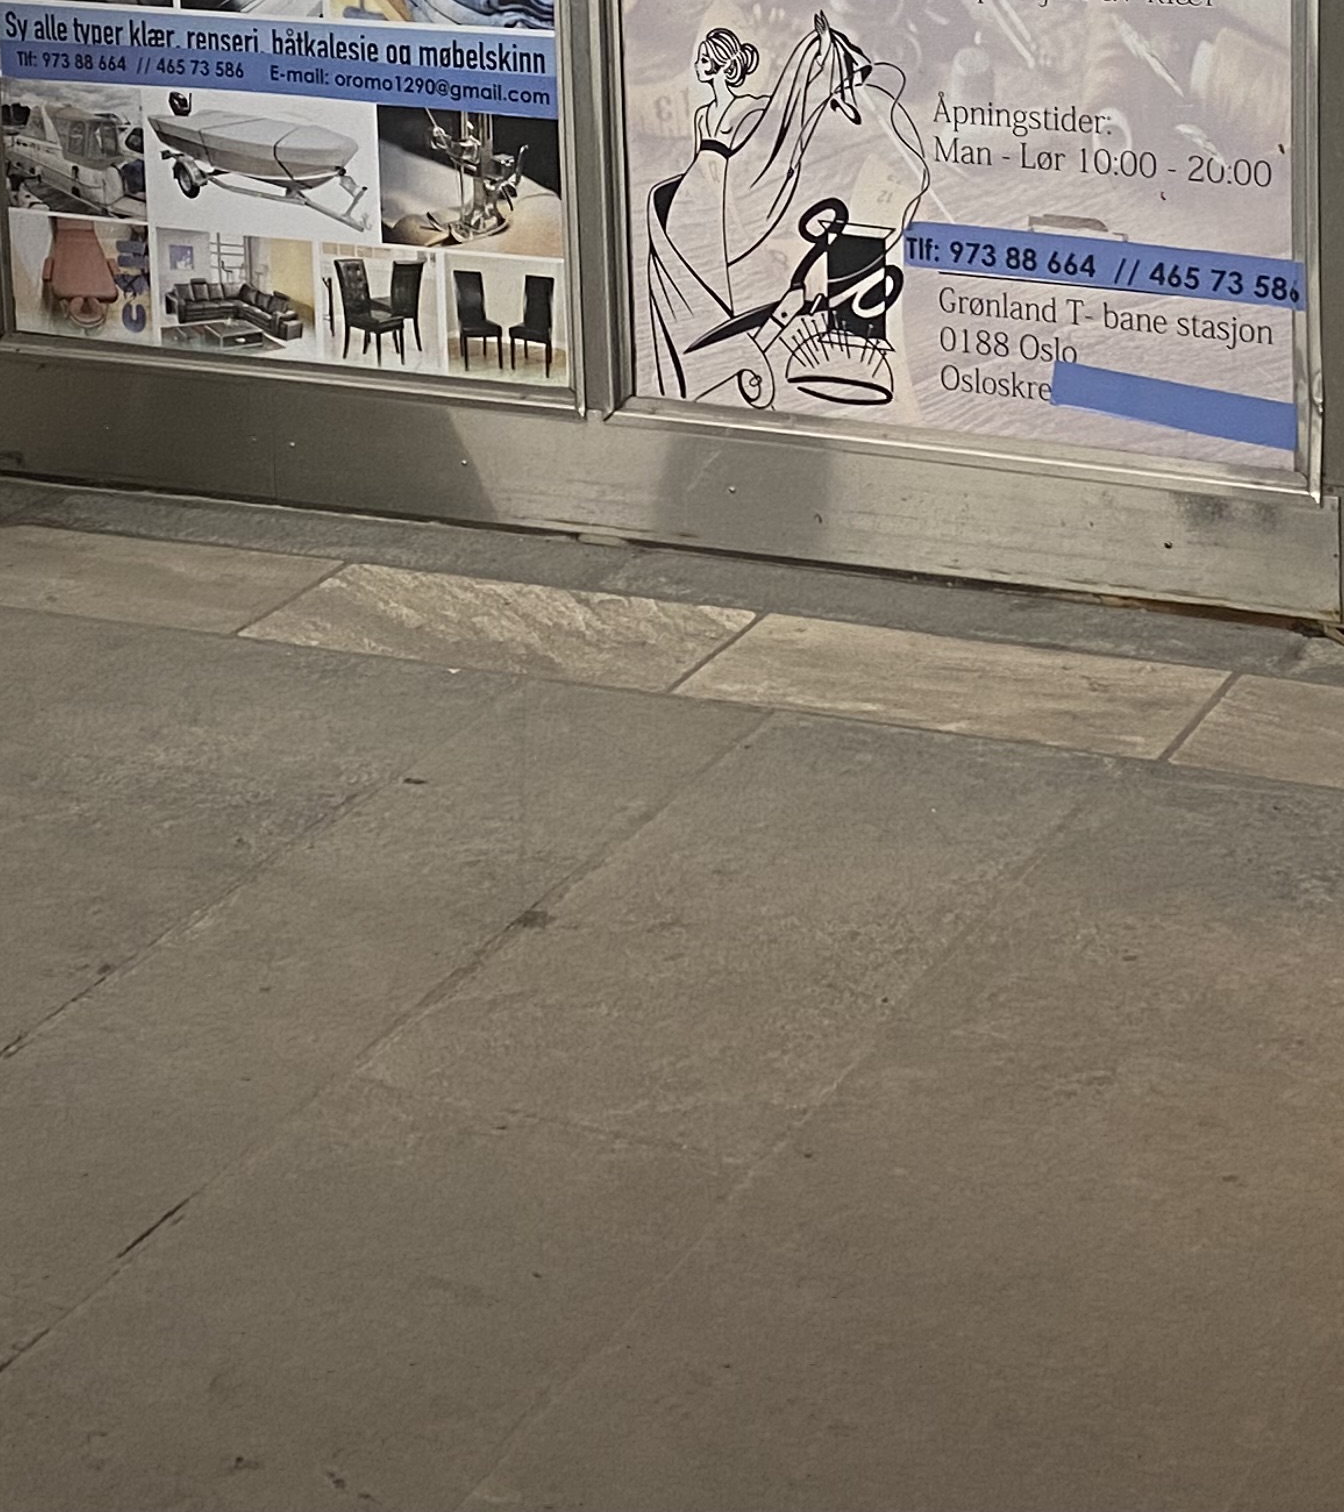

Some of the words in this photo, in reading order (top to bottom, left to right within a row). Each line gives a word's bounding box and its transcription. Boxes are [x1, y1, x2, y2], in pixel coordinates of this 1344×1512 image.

[5, 11, 28, 42] Sy
[34, 13, 68, 42] alle
[419, 39, 546, 74] møbelskinn
[43, 51, 70, 69] 973
[75, 53, 93, 70] 88
[99, 55, 126, 72] 664
[156, 58, 186, 75] 465
[190, 59, 209, 77] 73
[215, 61, 244, 79] 586
[270, 65, 329, 86] E-mail:
[335, 71, 551, 106] oromo1290@gmail.com
[933, 91, 1112, 137] Åpningstider:
[933, 136, 992, 166] Man
[1020, 142, 1066, 171] Lør
[1079, 148, 1157, 178] 10:00
[1188, 155, 1272, 187] 20:00
[906, 237, 940, 263] Tlf:
[949, 241, 997, 267] 973
[1006, 247, 1037, 272] 88
[1048, 251, 1096, 278] 664
[1149, 262, 1200, 290] 465
[1210, 269, 1244, 295] 73
[1253, 274, 1300, 303] 586
[939, 286, 1057, 324] Grønland
[1103, 302, 1167, 335] bane
[1177, 315, 1274, 350] stasjon
[940, 326, 1009, 358] 0188
[1020, 333, 1077, 364] Oslo
[940, 365, 1052, 401] Osloskre
